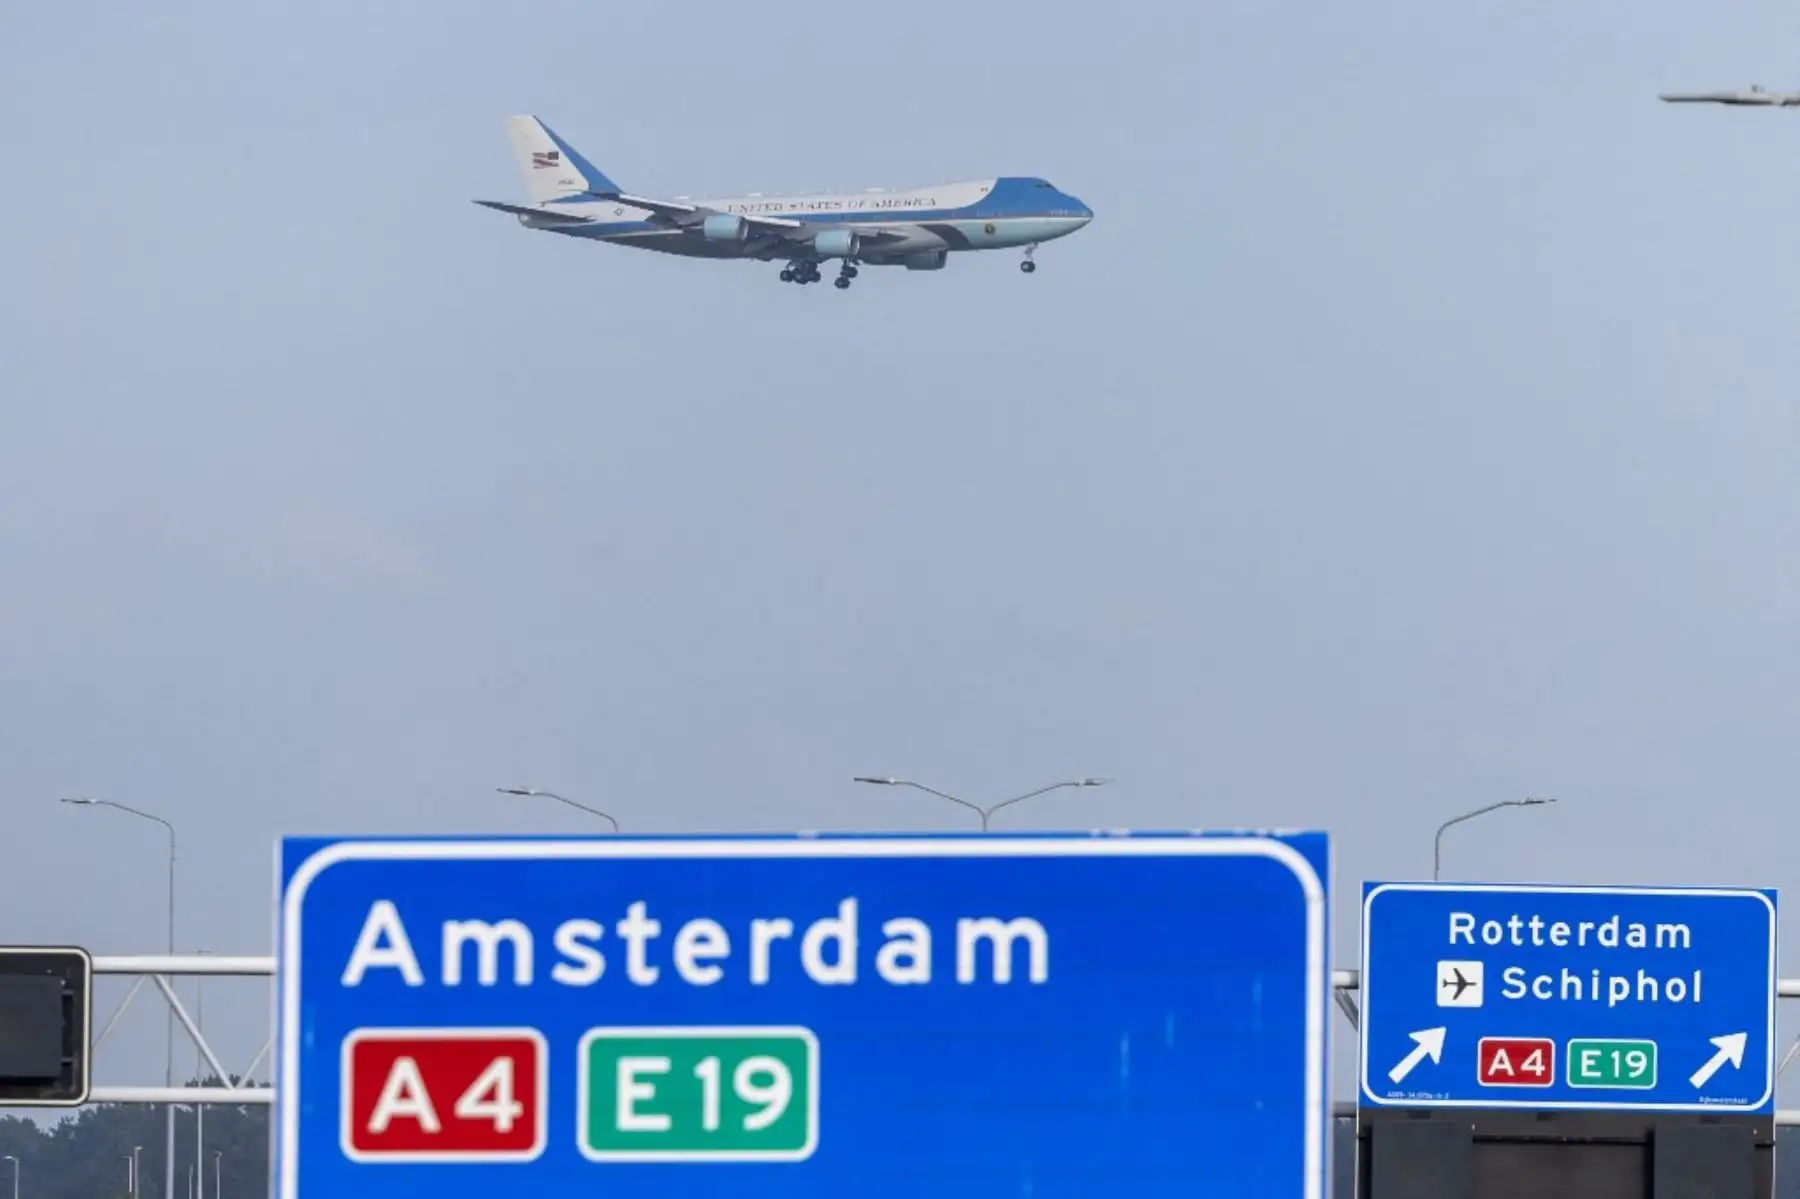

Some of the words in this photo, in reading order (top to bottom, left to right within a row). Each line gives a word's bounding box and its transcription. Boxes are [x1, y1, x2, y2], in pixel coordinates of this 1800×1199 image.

[728, 201, 782, 213] UNITED
[789, 200, 842, 211] STATES
[847, 199, 864, 209] OF
[871, 198, 936, 209] AMERICA
[342, 898, 1048, 986] Amsterdam
[1450, 912, 1690, 948] Rotterdam
[1502, 966, 1701, 1008] Schiphol
[1487, 1048, 1546, 1077] A4
[1581, 1050, 1648, 1078] E19
[367, 1055, 522, 1135] A4
[615, 1056, 793, 1132] E19
